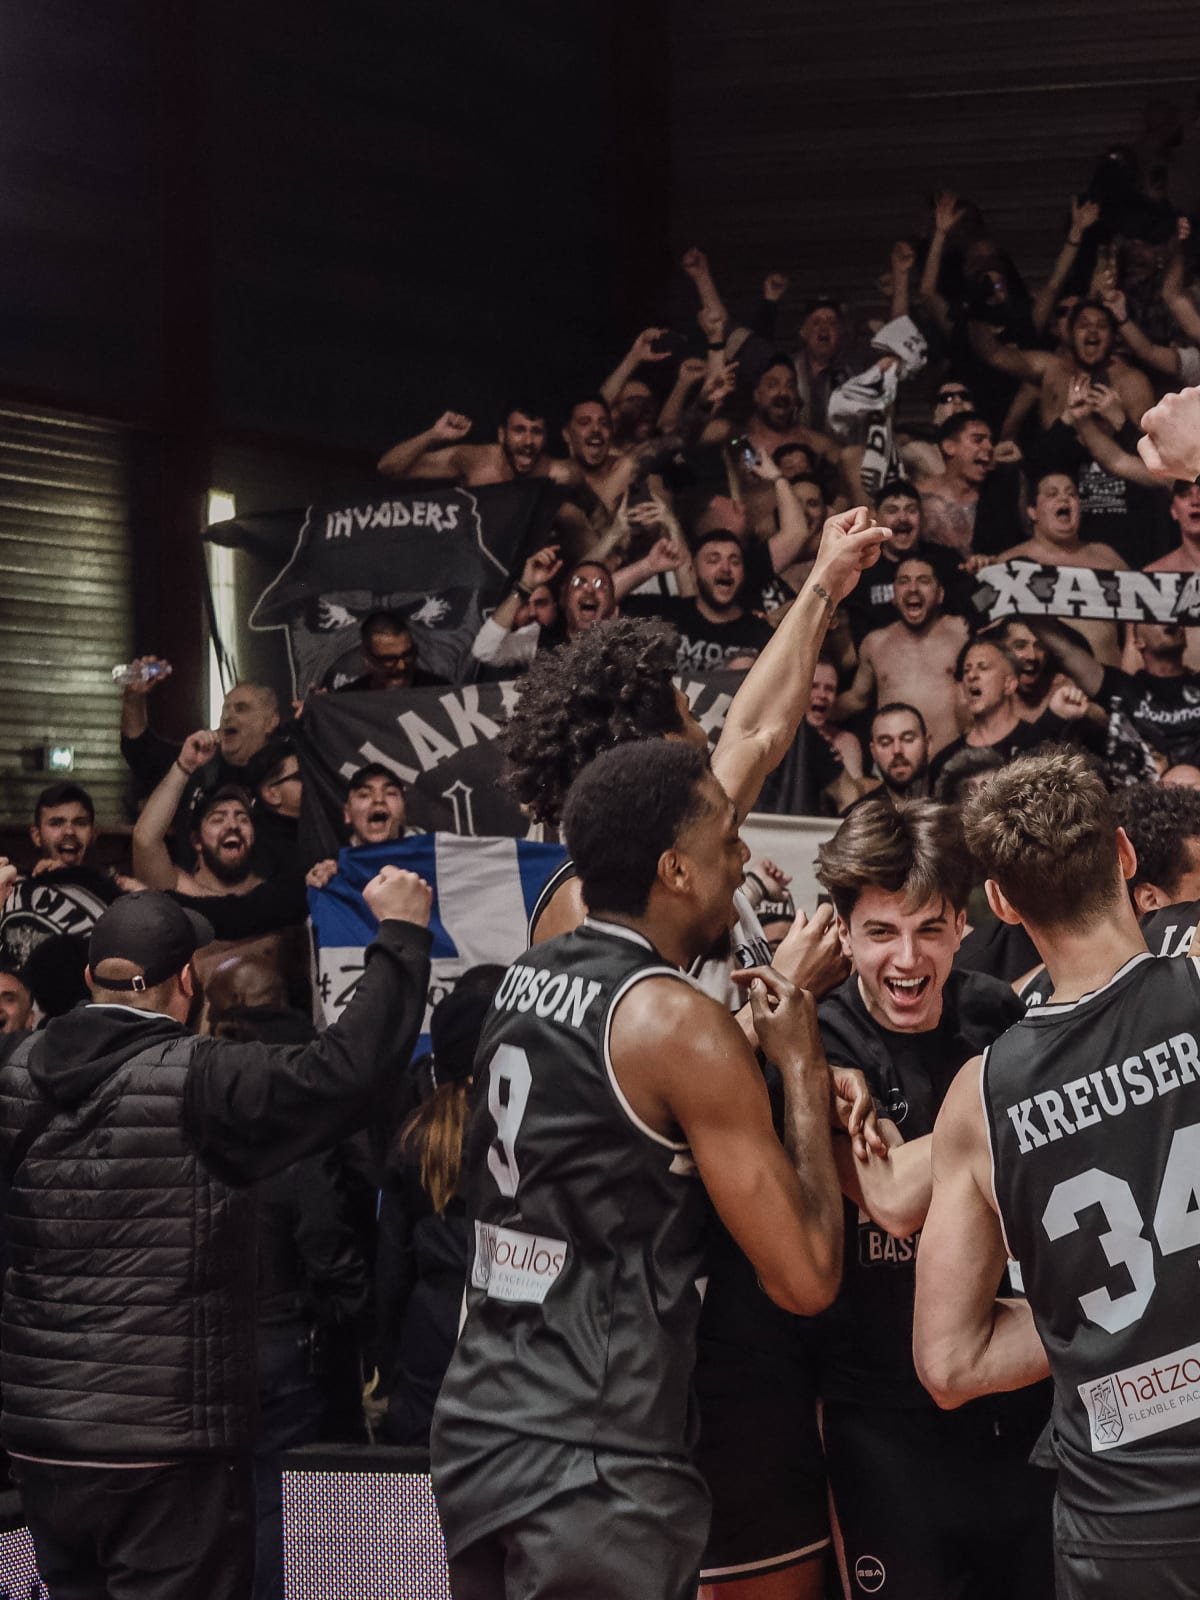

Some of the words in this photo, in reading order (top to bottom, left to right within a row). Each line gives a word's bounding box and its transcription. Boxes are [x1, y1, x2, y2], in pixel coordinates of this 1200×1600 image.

[325, 501, 460, 539] INVADERS
[494, 964, 602, 1029] UPSON
[487, 1043, 533, 1198] 9
[1128, 1399, 1177, 1424] FLEXIBLE
